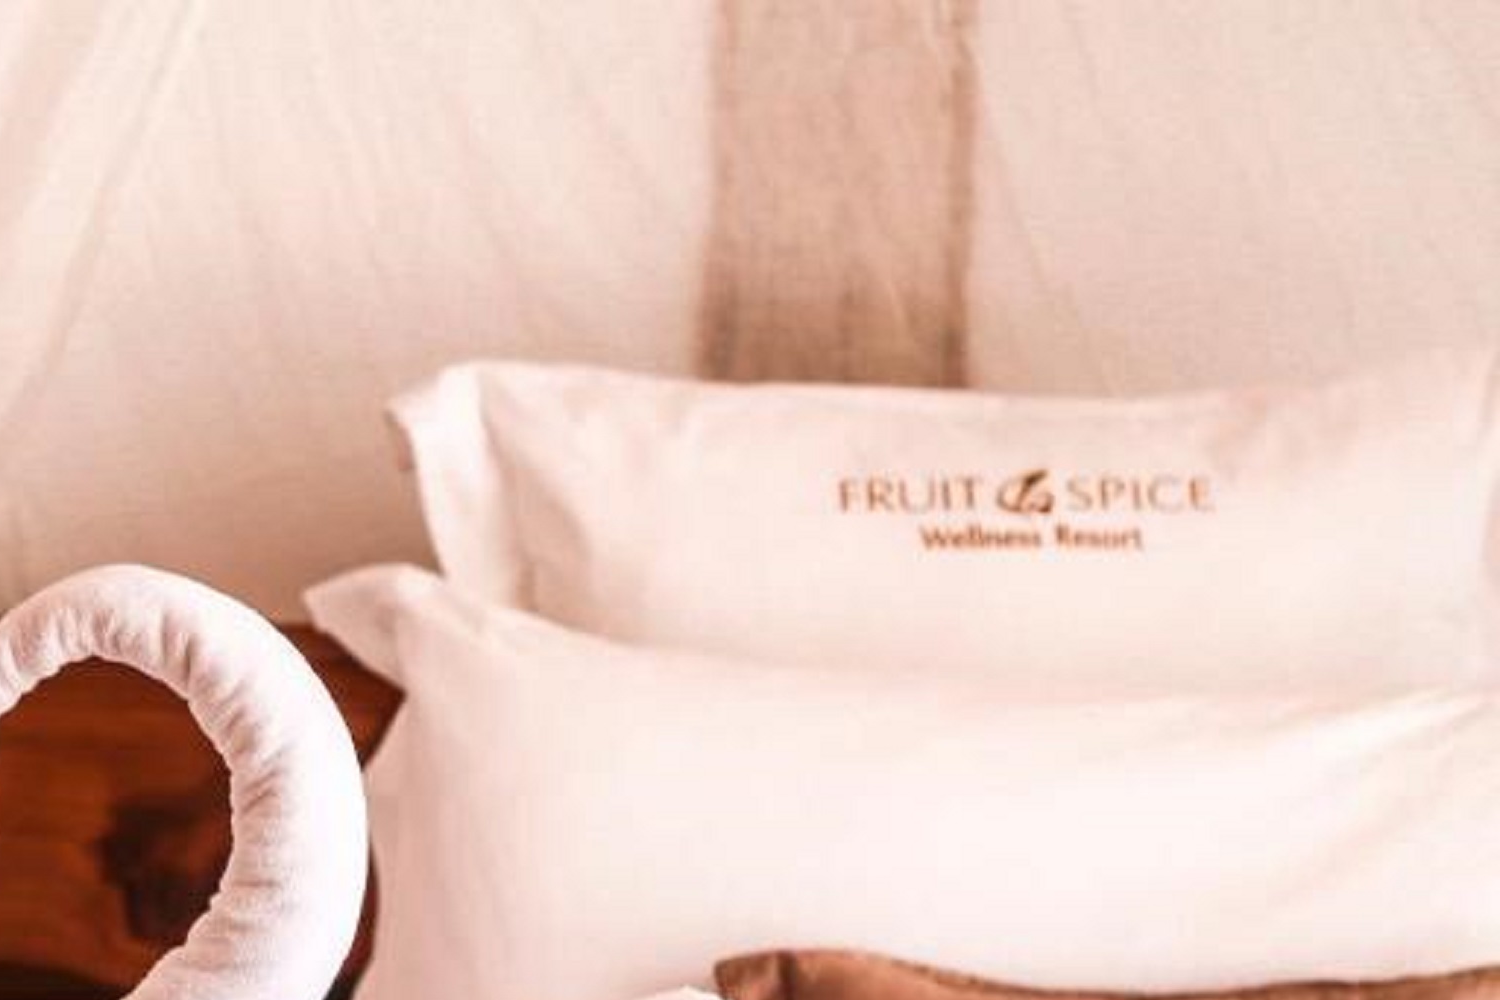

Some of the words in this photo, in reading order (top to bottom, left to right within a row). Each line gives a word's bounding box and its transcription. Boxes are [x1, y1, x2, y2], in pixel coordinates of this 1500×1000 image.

[837, 475, 980, 513] FRUIT
[1067, 475, 1216, 514] SPICE
[919, 525, 1042, 551] Wellness
[1055, 522, 1144, 551] Resort
